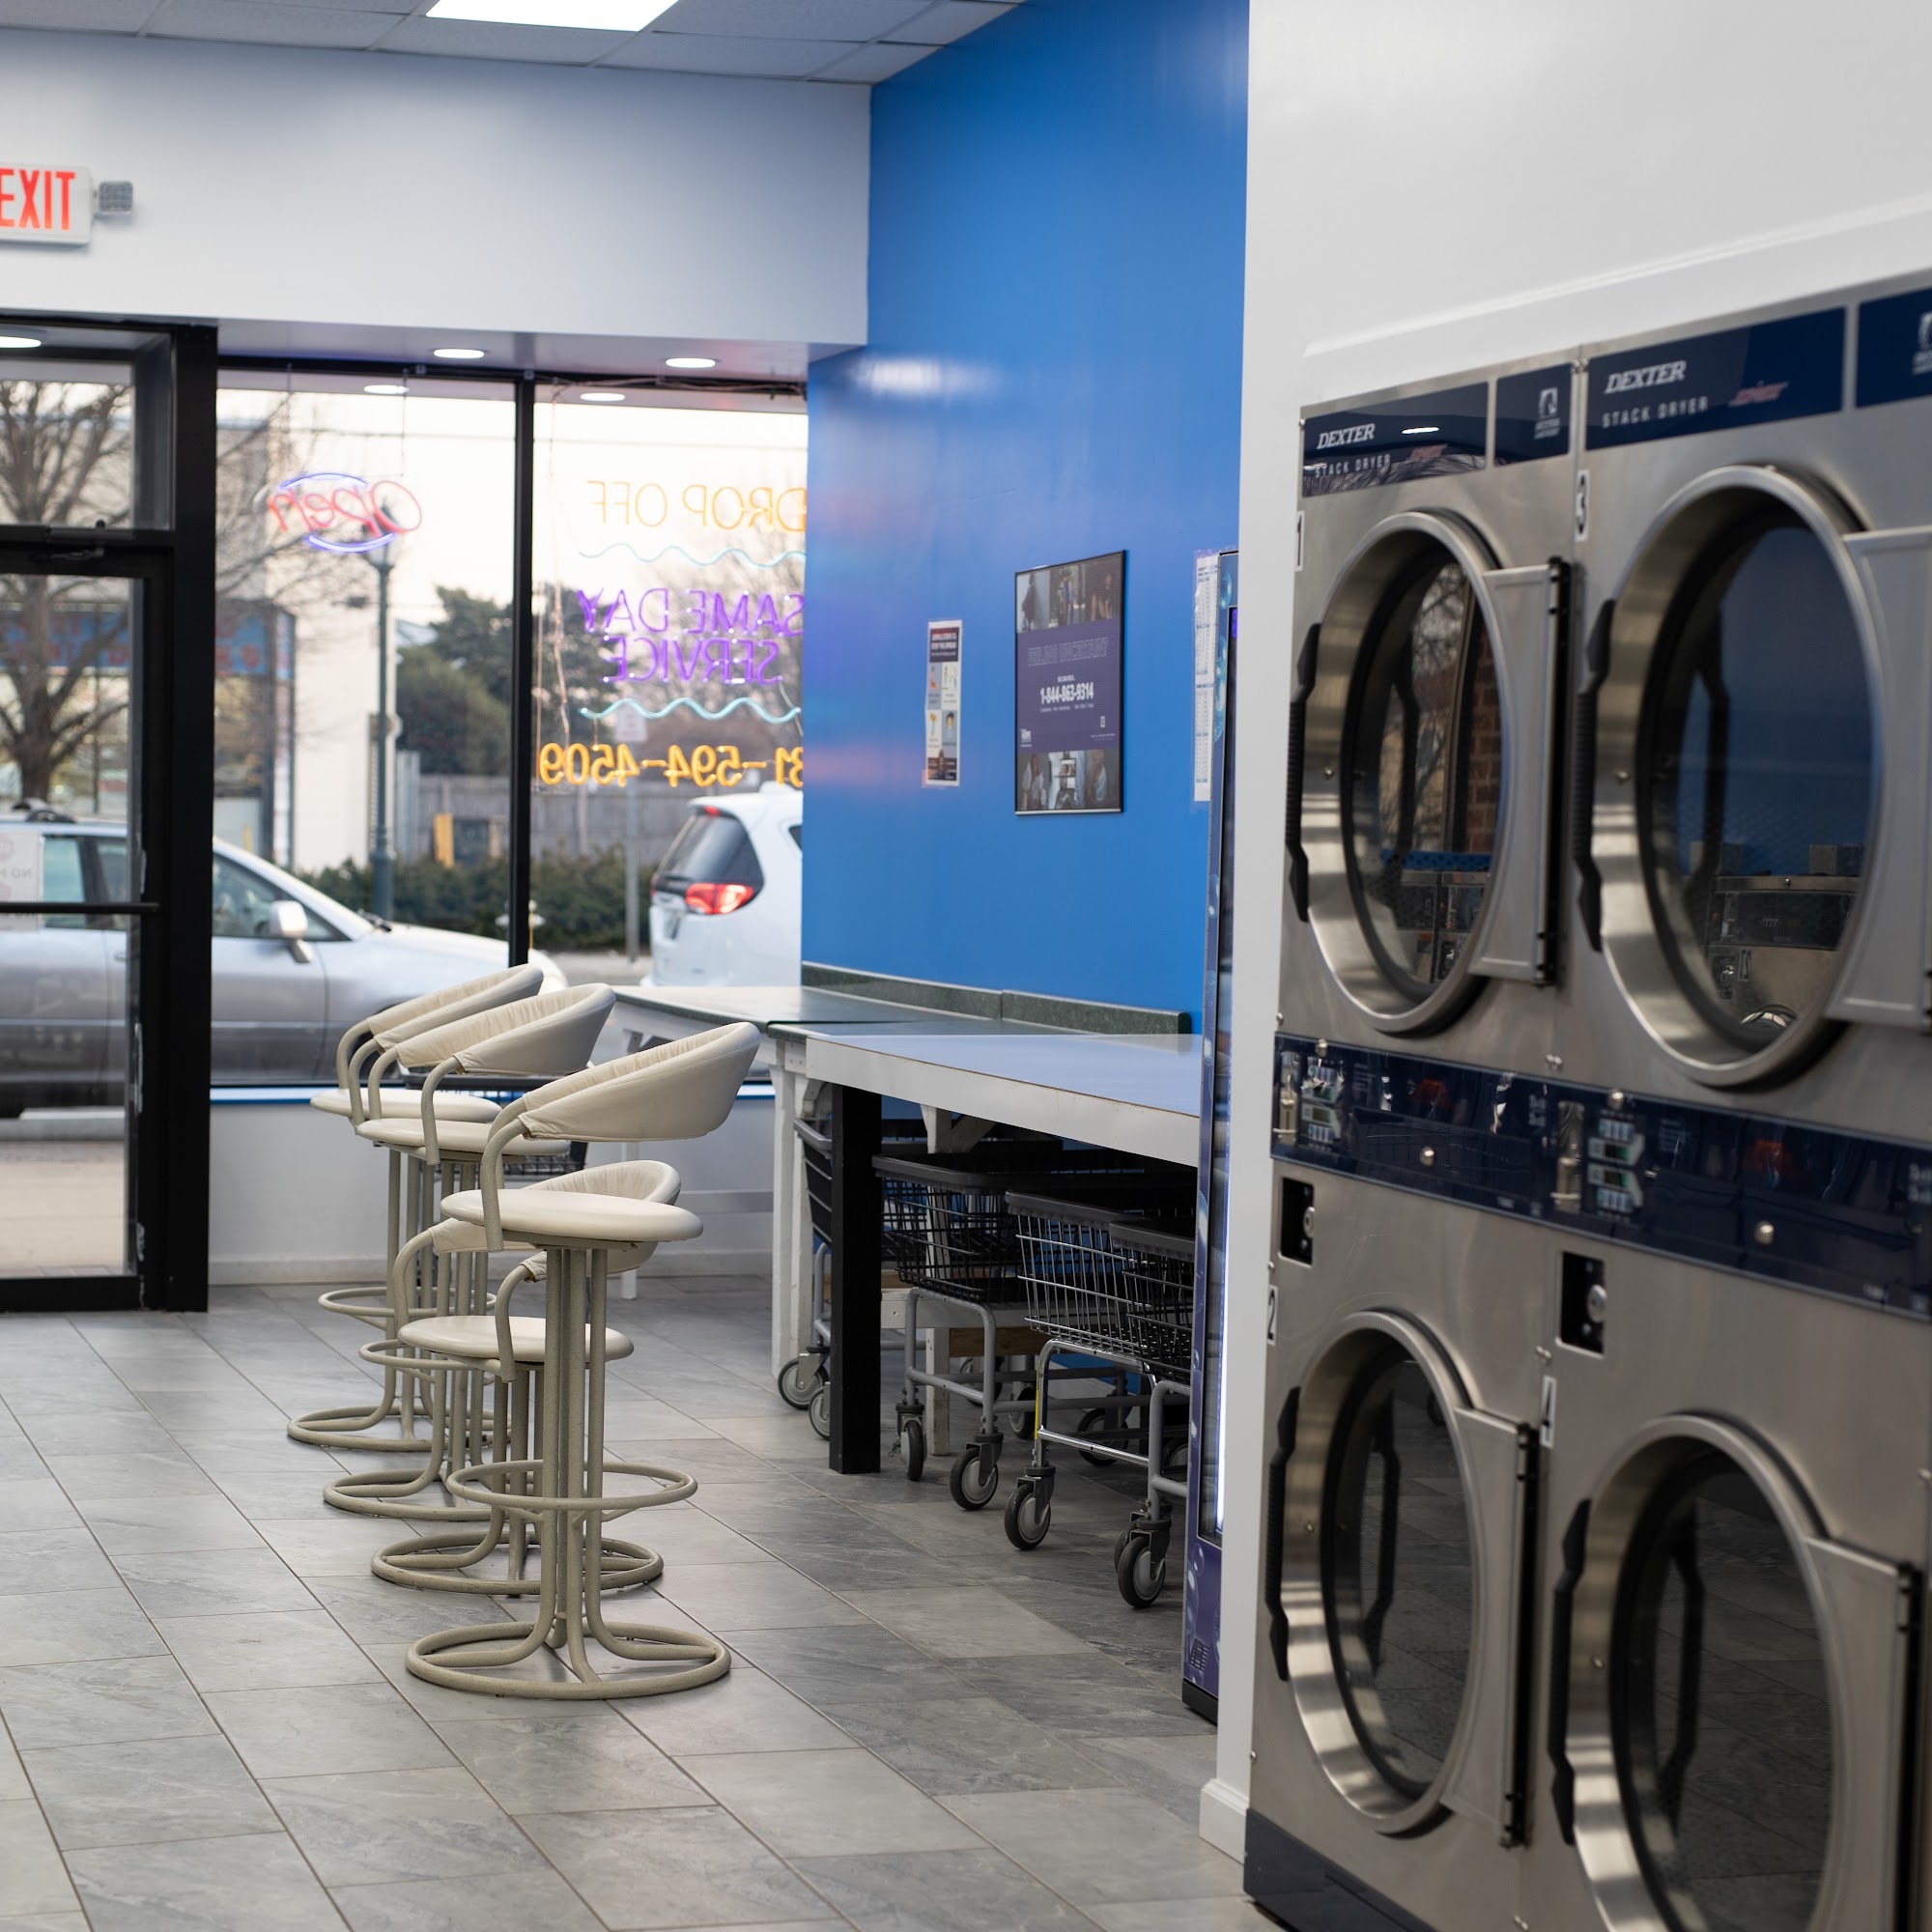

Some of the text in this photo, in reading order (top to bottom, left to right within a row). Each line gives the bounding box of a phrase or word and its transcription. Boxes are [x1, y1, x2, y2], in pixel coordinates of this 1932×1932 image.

[0, 167, 75, 230] EXIT
[1604, 360, 1687, 394] DEXTER
[1602, 396, 1709, 428] STACK DRYER
[1316, 423, 1376, 450] DEXTER
[1315, 459, 1350, 478] STACK
[1355, 453, 1391, 471] DRYER
[1266, 1289, 1276, 1341] 2
